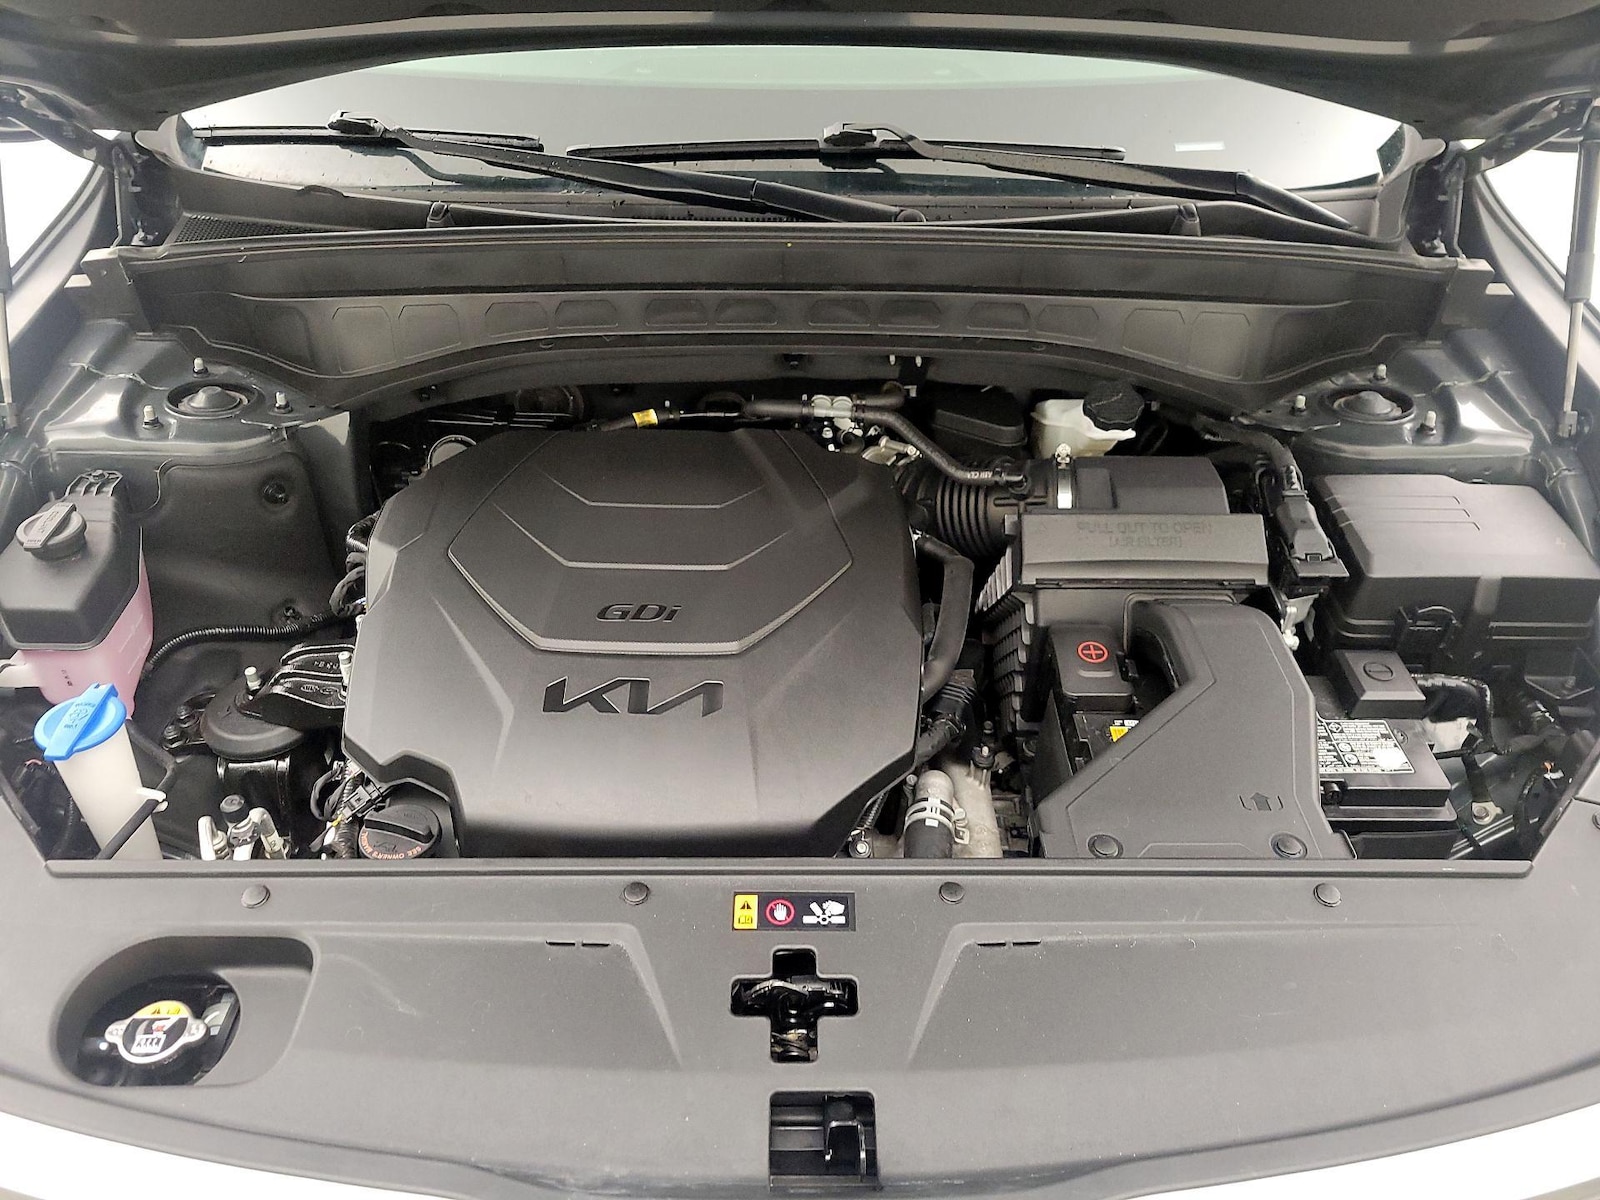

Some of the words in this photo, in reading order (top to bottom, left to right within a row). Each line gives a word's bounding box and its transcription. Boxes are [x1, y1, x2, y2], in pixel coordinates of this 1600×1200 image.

[1076, 521, 1113, 534] PULL
[1117, 521, 1145, 534] OUT
[1150, 521, 1169, 534] TO
[1174, 521, 1213, 534] OPEN
[595, 603, 682, 623] GDi
[542, 676, 724, 717] KIA
[406, 846, 422, 857] SEE
